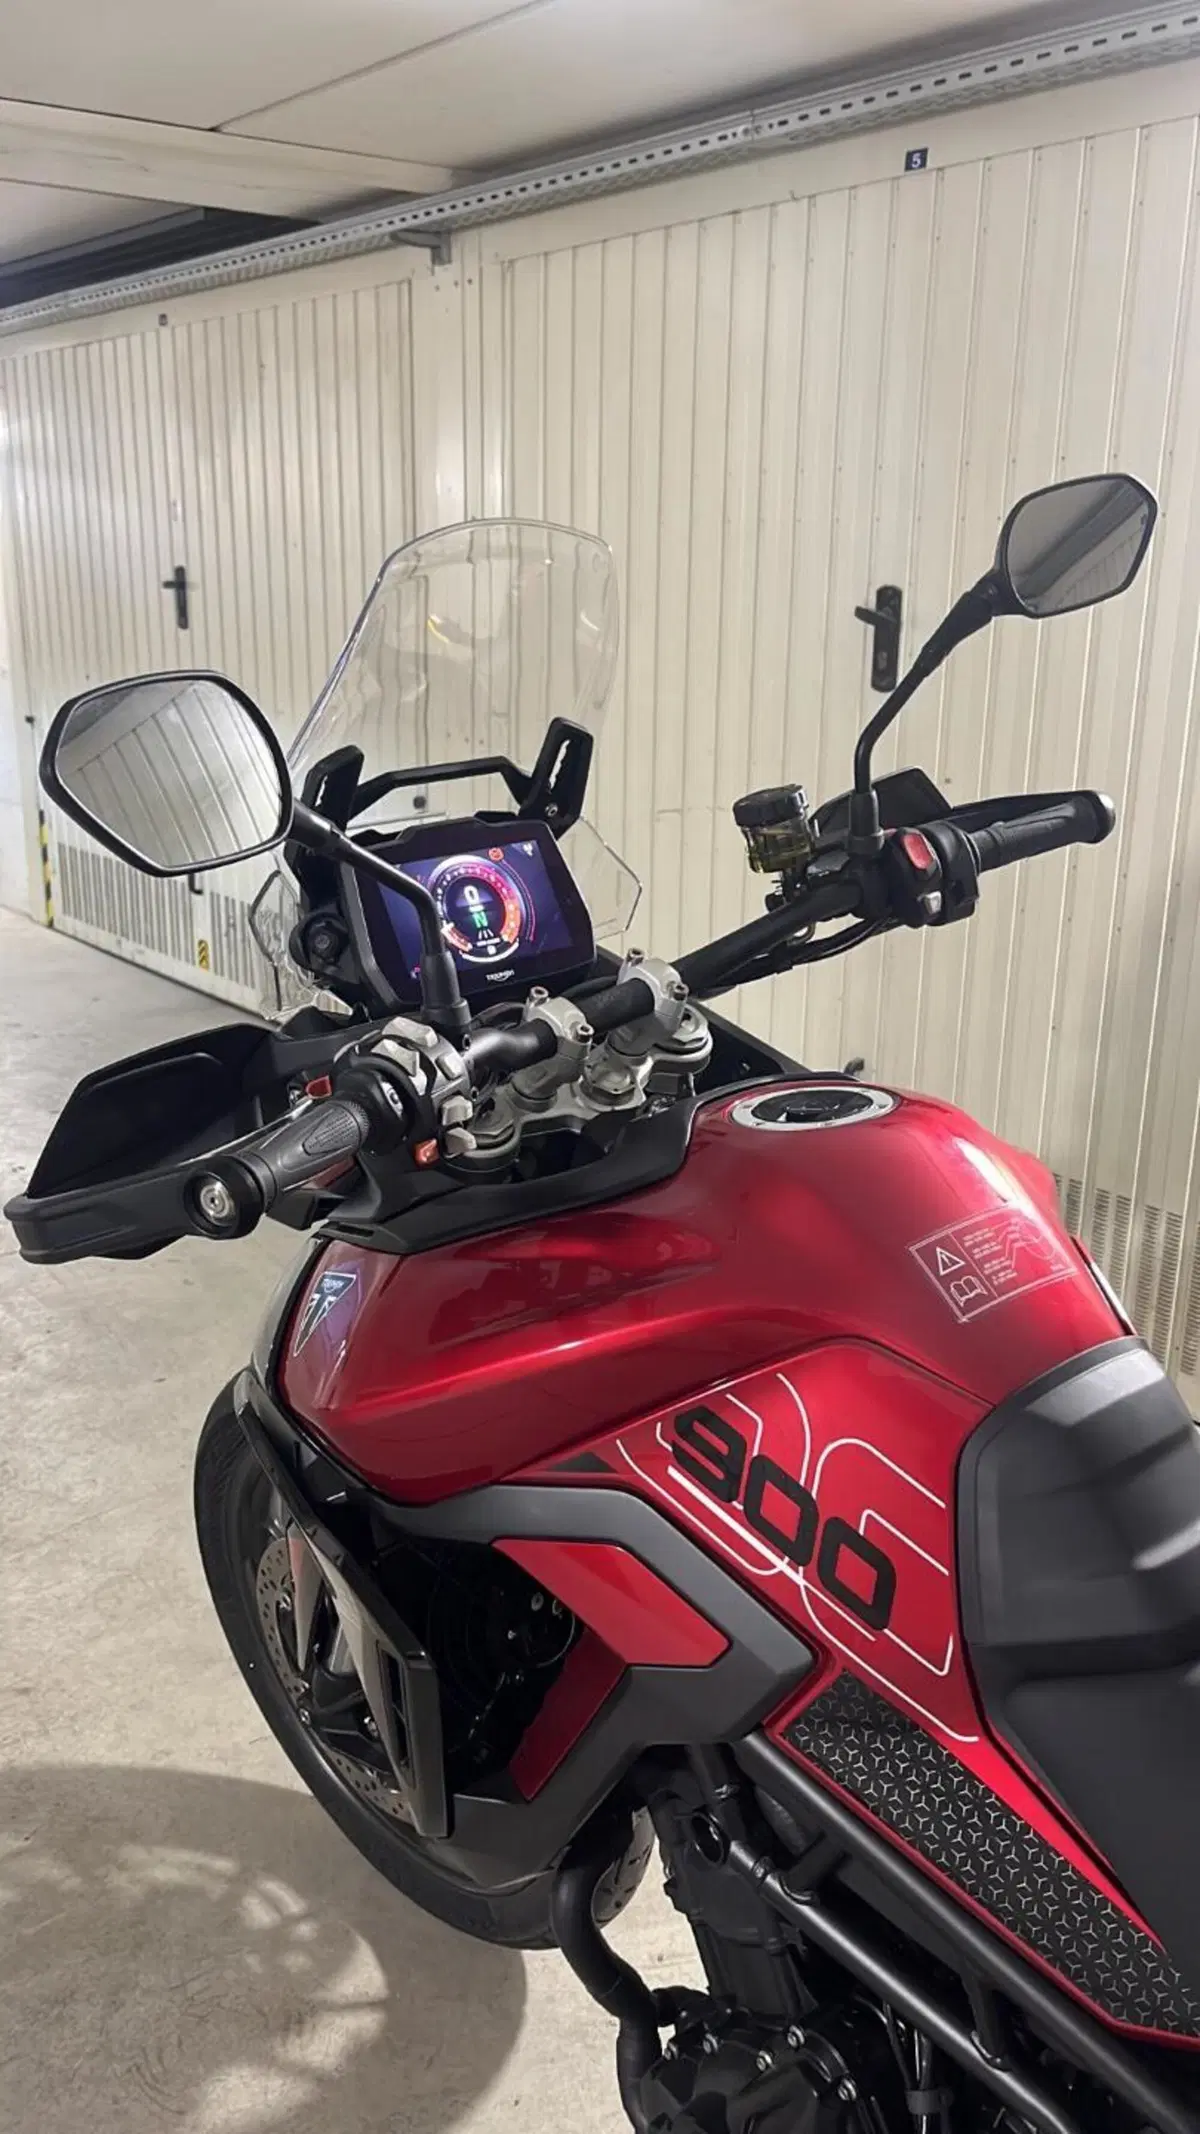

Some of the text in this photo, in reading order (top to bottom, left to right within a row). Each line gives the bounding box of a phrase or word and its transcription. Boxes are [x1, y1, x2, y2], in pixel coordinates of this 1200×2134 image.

[911, 152, 921, 168] 5
[464, 885, 480, 905] 0
[472, 910, 488, 928] N
[671, 1405, 897, 1631] 900
